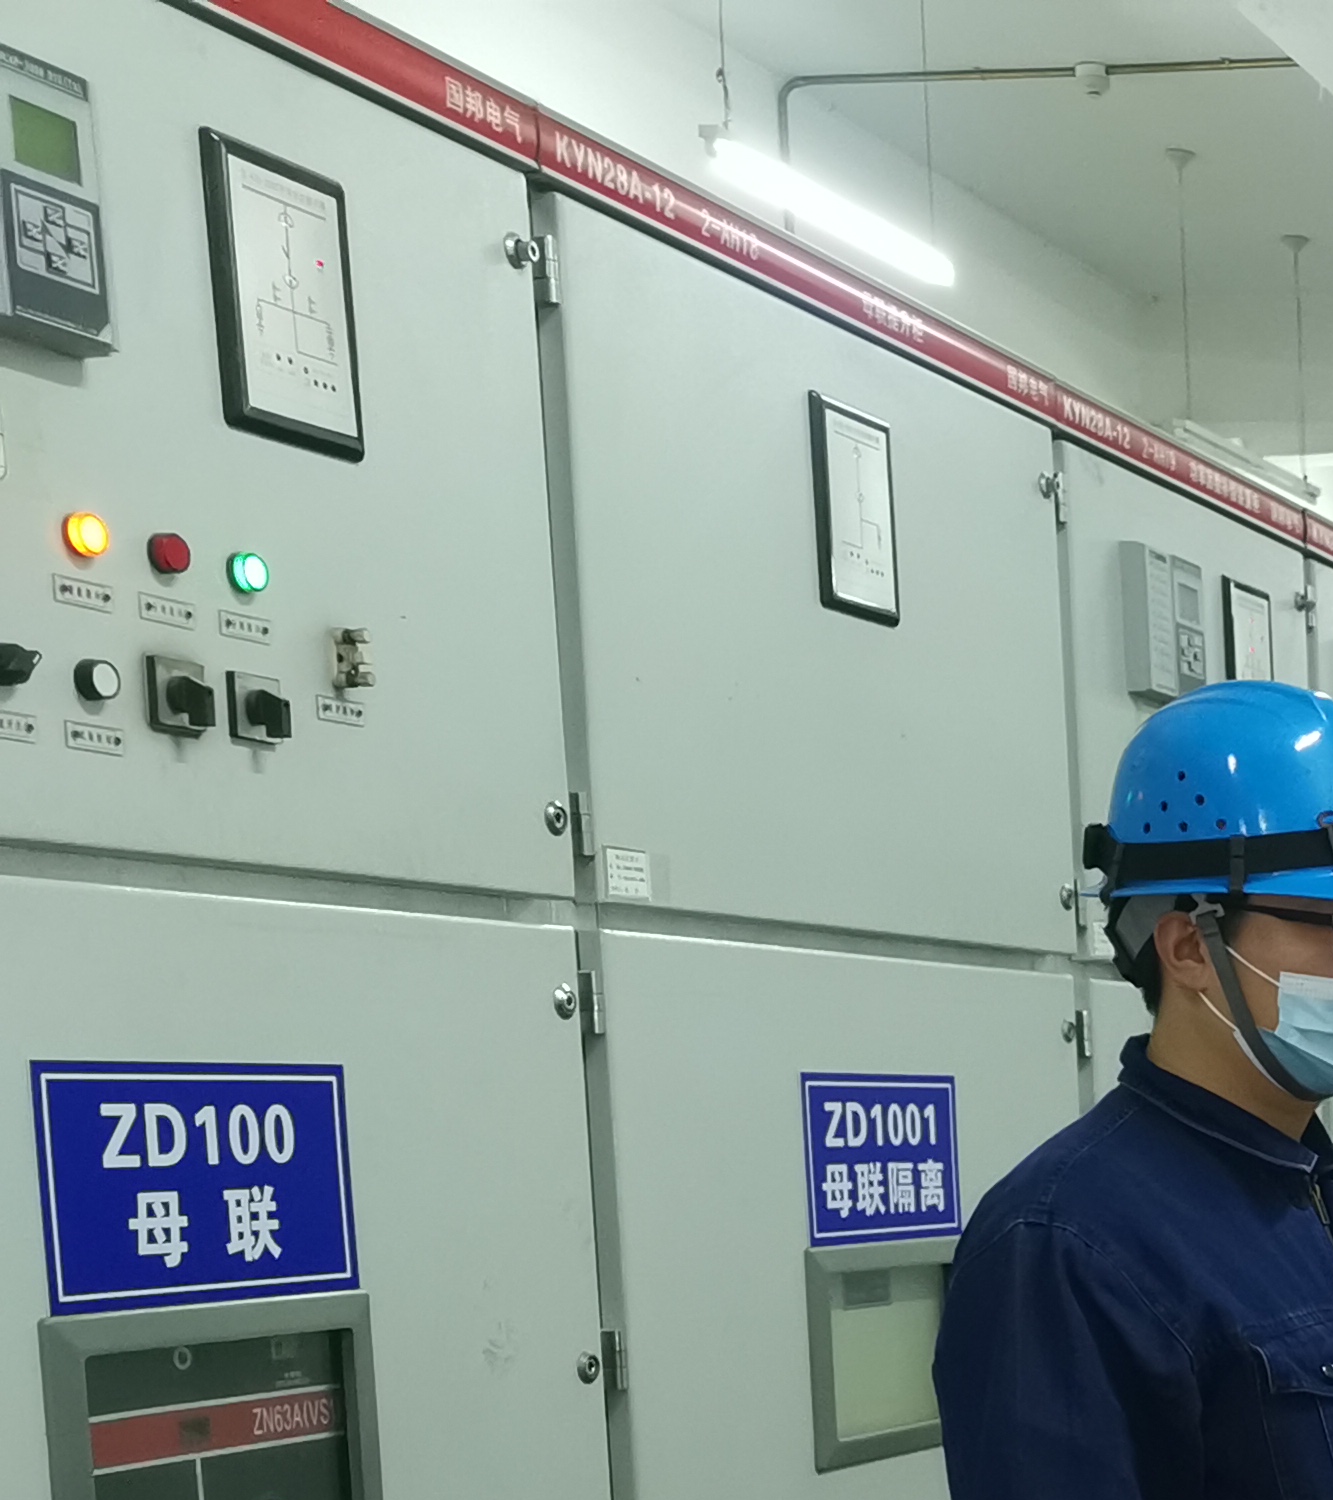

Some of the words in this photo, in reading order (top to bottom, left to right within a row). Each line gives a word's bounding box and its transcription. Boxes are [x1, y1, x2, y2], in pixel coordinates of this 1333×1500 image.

[444, 76, 523, 144] 国邦电气
[554, 131, 677, 221] KYN28A-12
[1062, 395, 1132, 450] KYN28A-12
[99, 1102, 296, 1169] ZD100
[823, 1101, 937, 1148] ZD1001
[821, 1157, 945, 1219] 母联隔离
[128, 1184, 283, 1269] 母联
